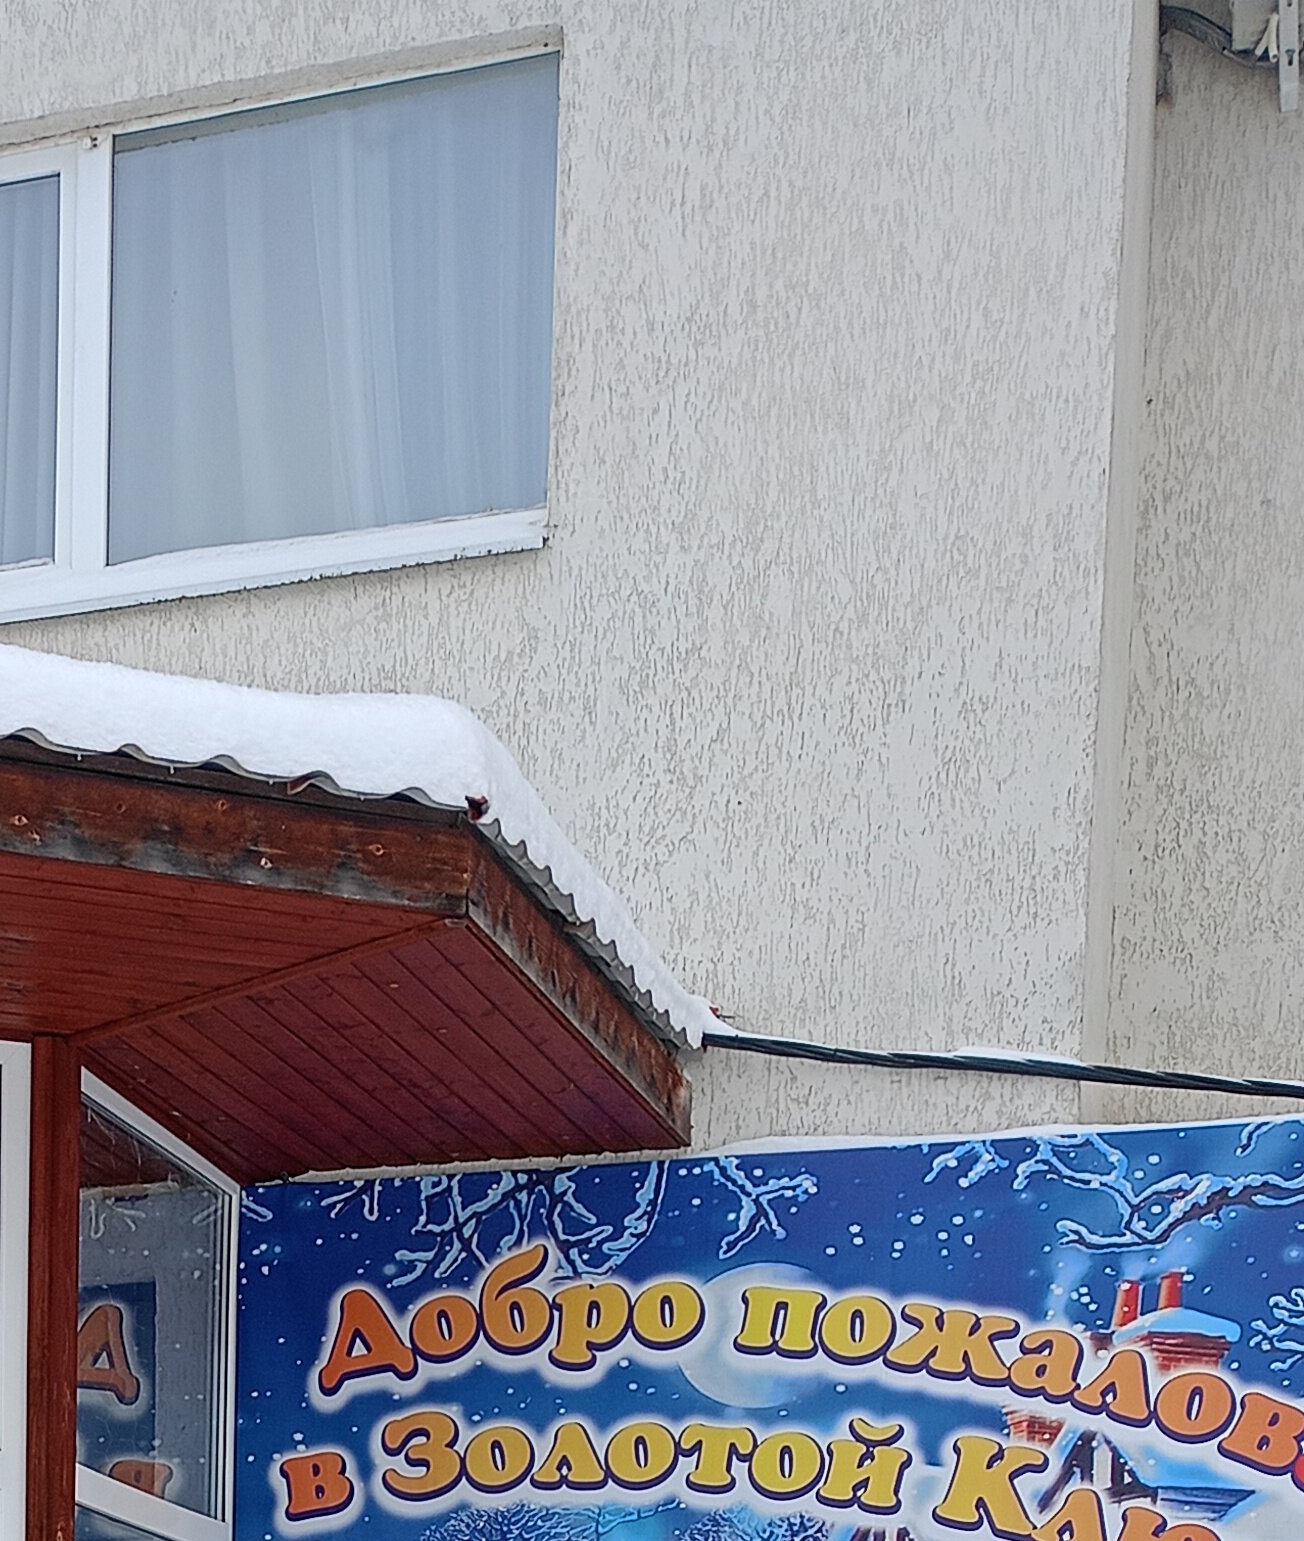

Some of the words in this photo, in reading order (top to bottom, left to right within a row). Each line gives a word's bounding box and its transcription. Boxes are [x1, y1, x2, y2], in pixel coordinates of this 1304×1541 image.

[317, 1241, 704, 1398] Добро
[734, 1285, 1304, 1492] пожалов
[284, 1447, 355, 1523] в
[380, 1410, 910, 1513] Золотой
